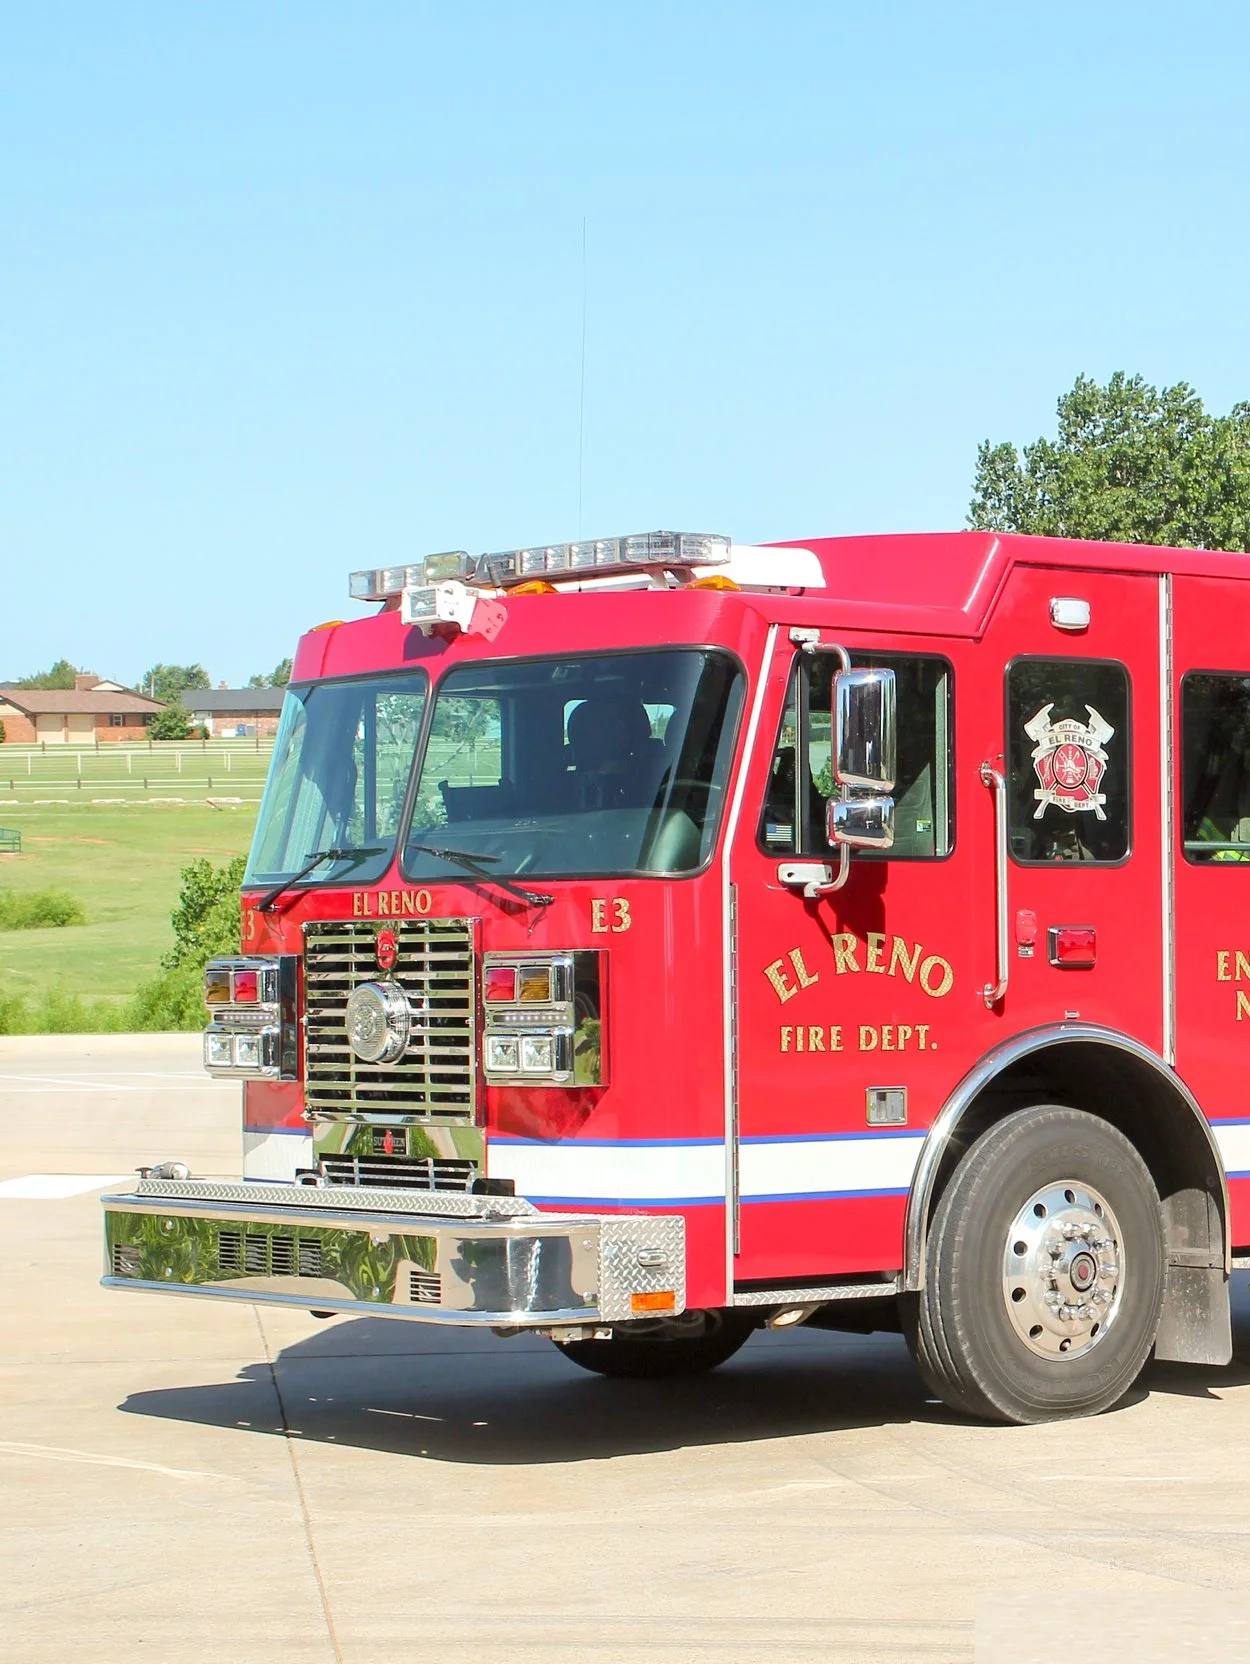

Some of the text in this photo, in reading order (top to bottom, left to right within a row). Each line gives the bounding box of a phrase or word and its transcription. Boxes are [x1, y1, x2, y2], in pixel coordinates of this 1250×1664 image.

[1048, 734, 1093, 747] EL RENO
[353, 889, 432, 917] EL RENO
[590, 897, 632, 933] E3
[763, 931, 954, 1005] EL RENO
[779, 1024, 938, 1052] FIRE DEPT.
